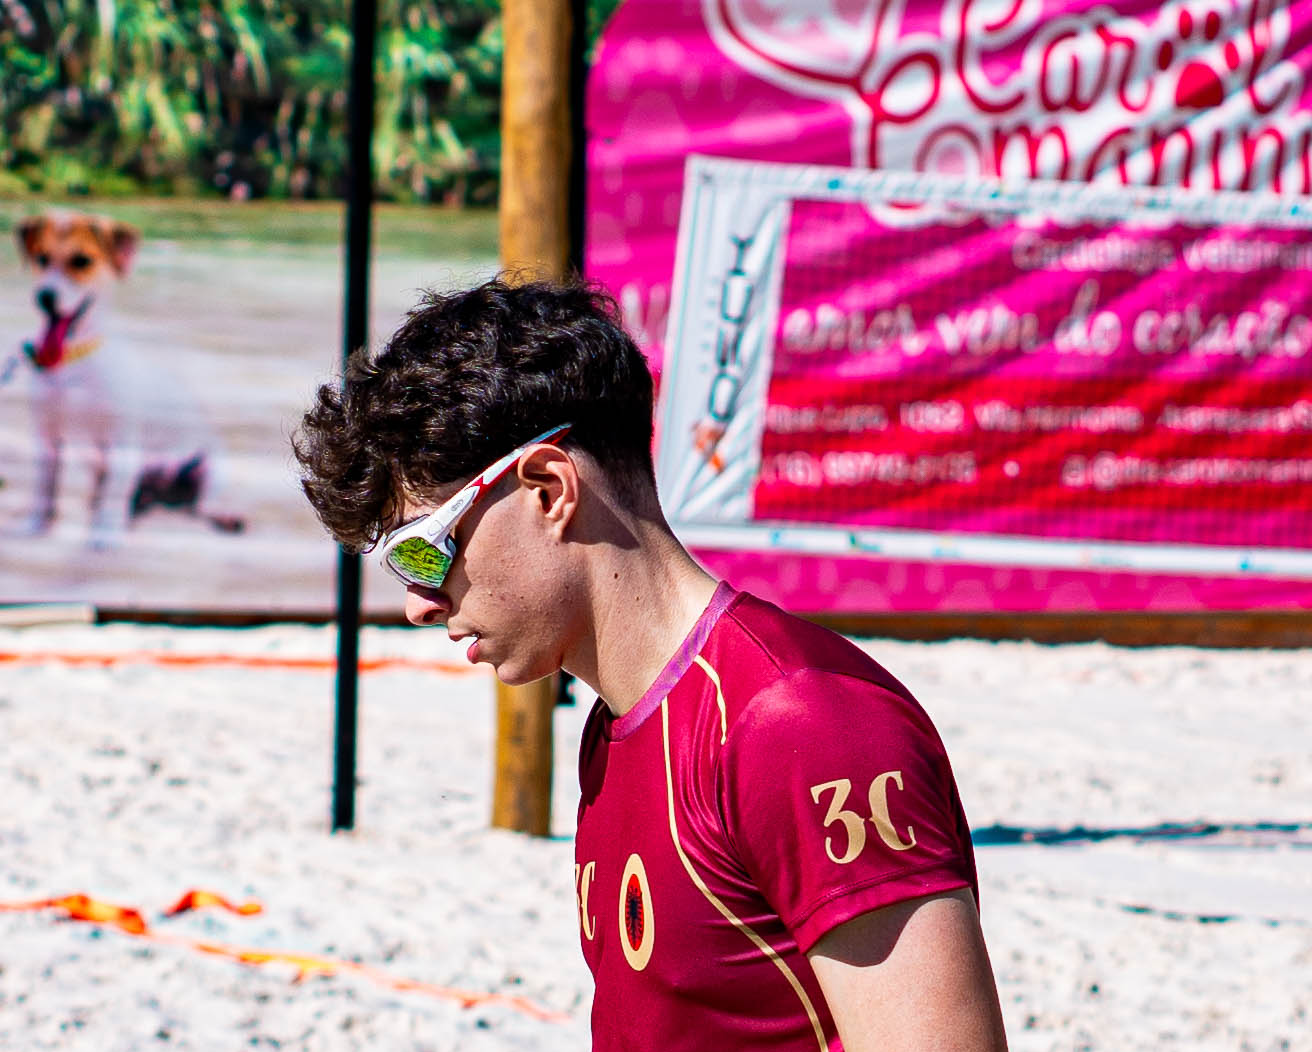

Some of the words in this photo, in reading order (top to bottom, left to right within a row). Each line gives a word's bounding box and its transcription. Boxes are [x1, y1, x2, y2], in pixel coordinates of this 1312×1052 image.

[934, 305, 1040, 355] vem
[1053, 278, 1123, 356] do
[810, 770, 917, 864] 3C
